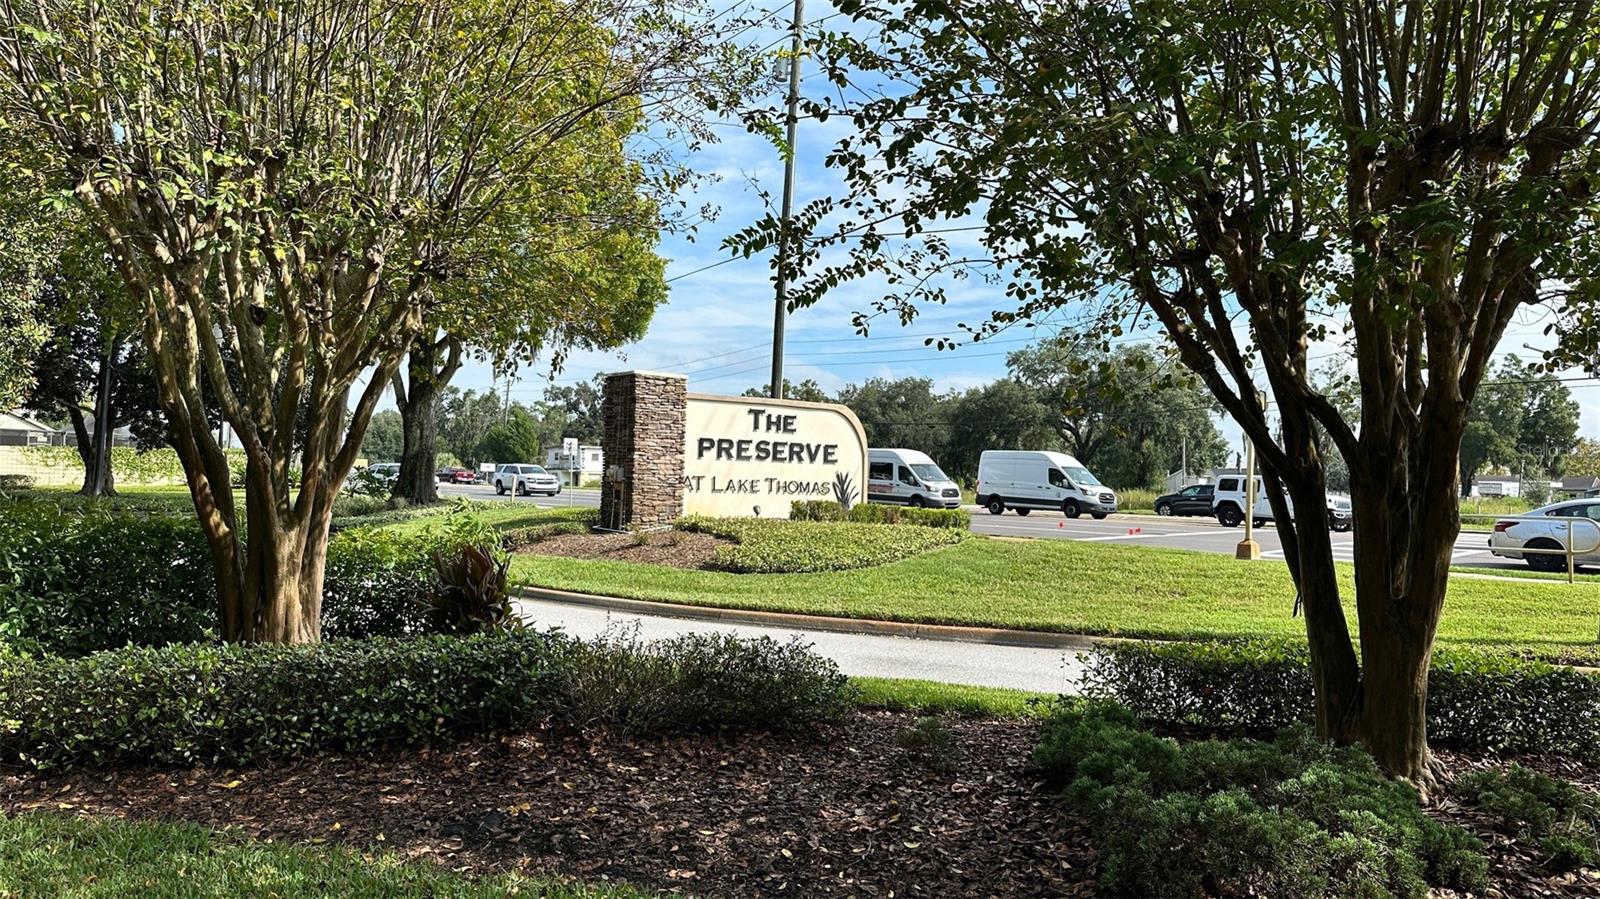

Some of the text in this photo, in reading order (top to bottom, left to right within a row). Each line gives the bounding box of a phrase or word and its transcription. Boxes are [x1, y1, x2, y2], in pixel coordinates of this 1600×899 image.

[748, 408, 797, 433] THE
[697, 437, 838, 464] PRESERVE
[682, 475, 831, 495] AT LAKE THOMAS
